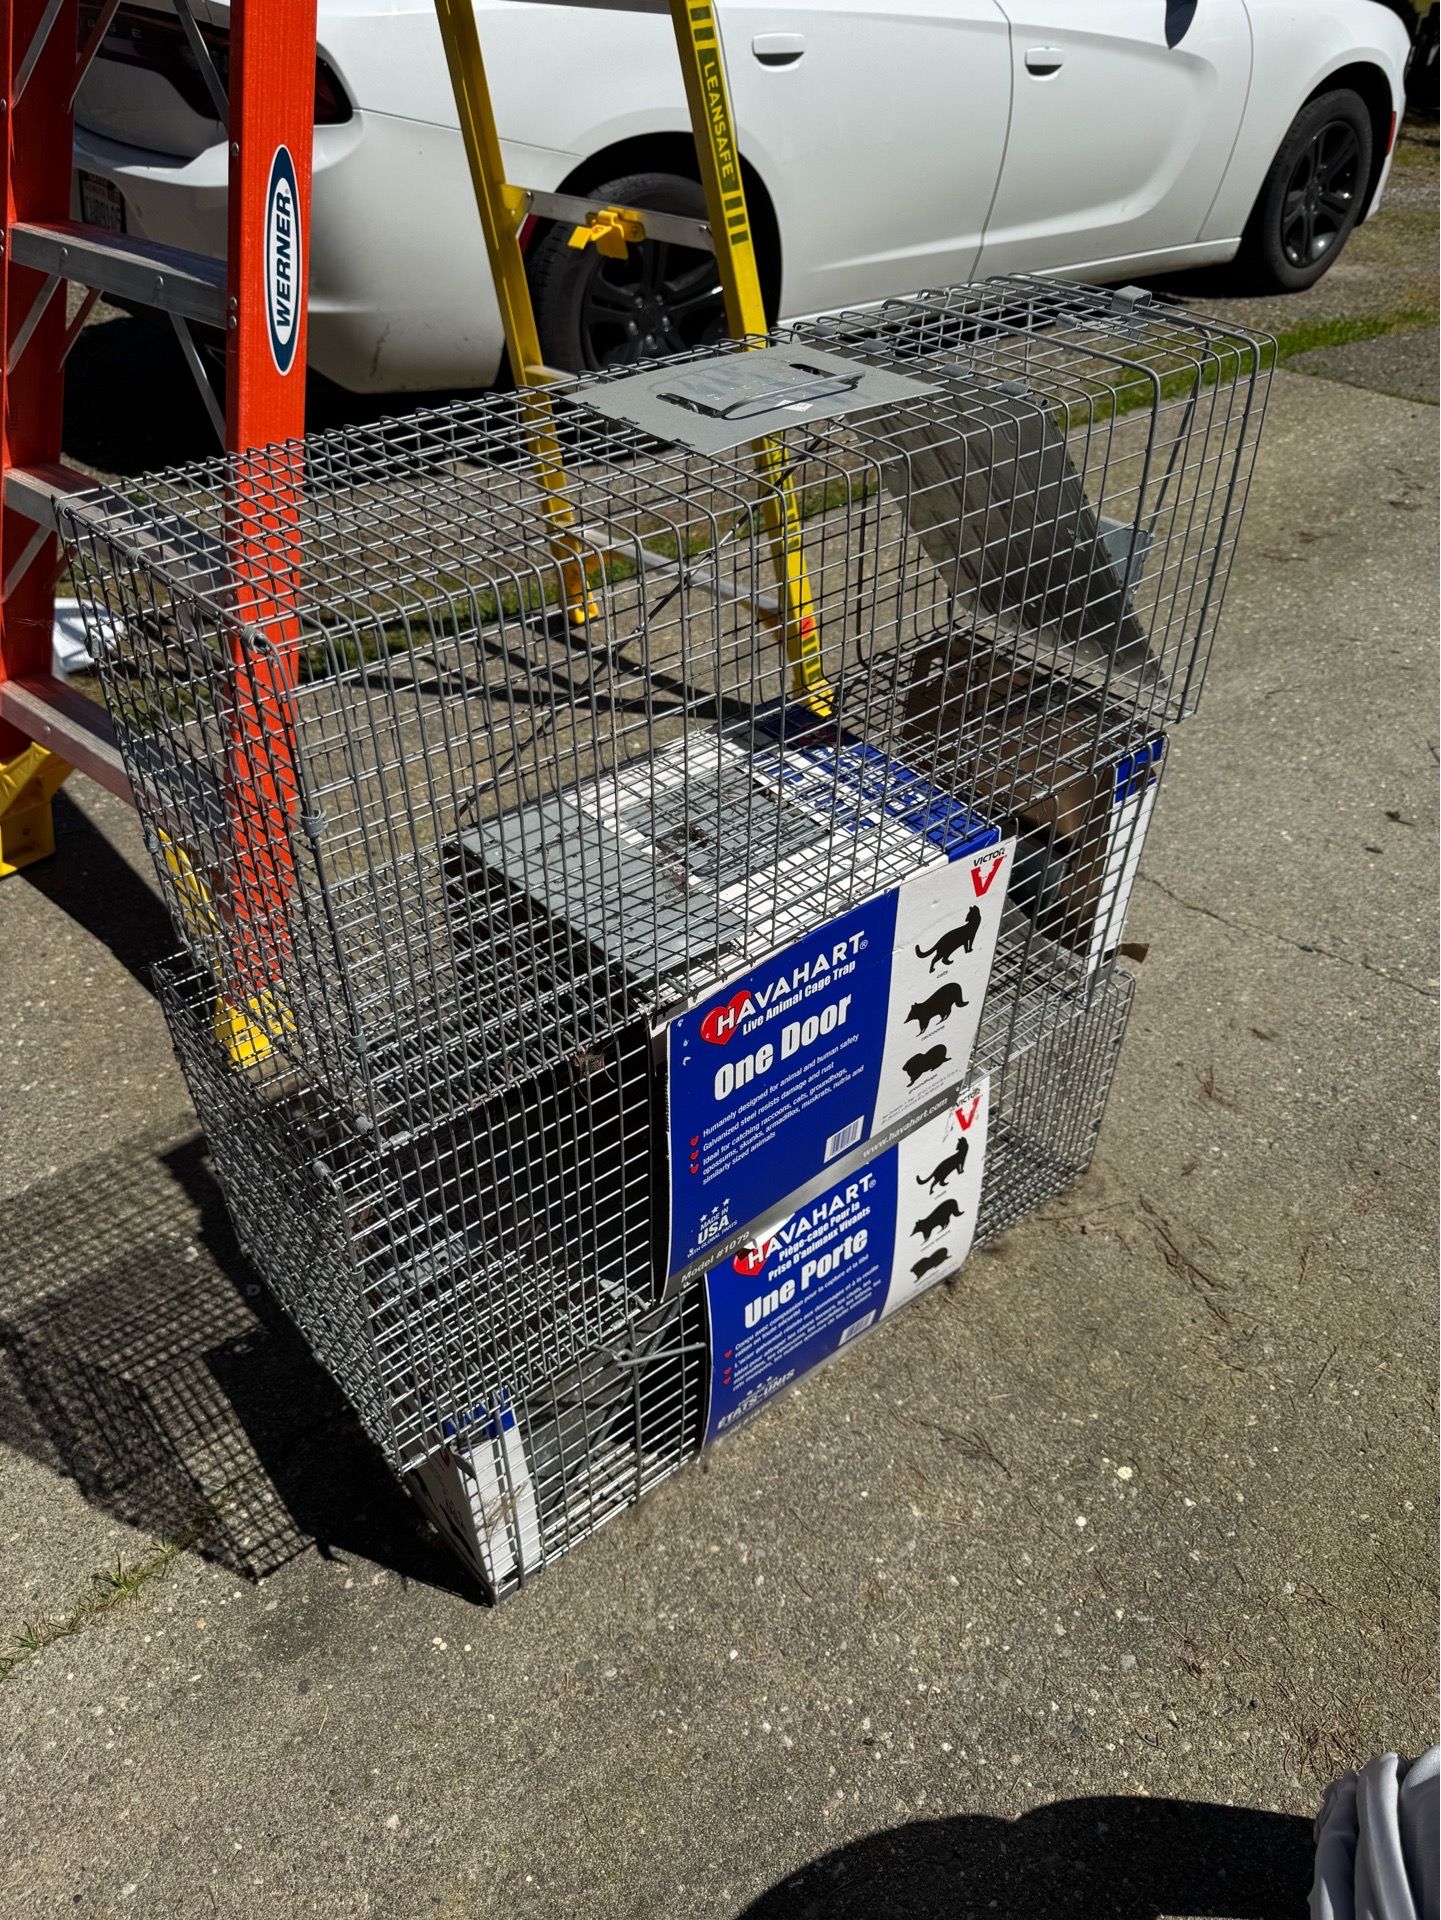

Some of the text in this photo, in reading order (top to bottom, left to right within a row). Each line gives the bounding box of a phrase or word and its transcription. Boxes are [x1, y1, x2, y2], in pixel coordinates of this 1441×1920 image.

[704, 61, 733, 179] LEANSAFE
[973, 847, 1005, 867] VICTOR
[743, 961, 856, 1036] Live Animal Cage Trap
[714, 994, 852, 1101] One Door
[702, 1065, 865, 1175] opossums, skunks, armadillos, muskrats, nutria and
[703, 1033, 860, 1138] Humanely designed for animal and human safety
[703, 1062, 835, 1152] Galvanized steel resists damage and rust
[703, 1068, 848, 1166] Ideal for catching raccoons, cats, groundhogs,
[702, 1131, 776, 1186] similarly sized animals
[863, 1098, 948, 1158] www.havahart.com
[697, 1215, 729, 1245] USA
[700, 1206, 729, 1231] MADE IN
[768, 1206, 871, 1282] Prise D'animaux Vivants
[779, 1201, 860, 1262] Piège-cage Pour la
[681, 1231, 750, 1283] Model #1079
[744, 1229, 868, 1329] Une Porte
